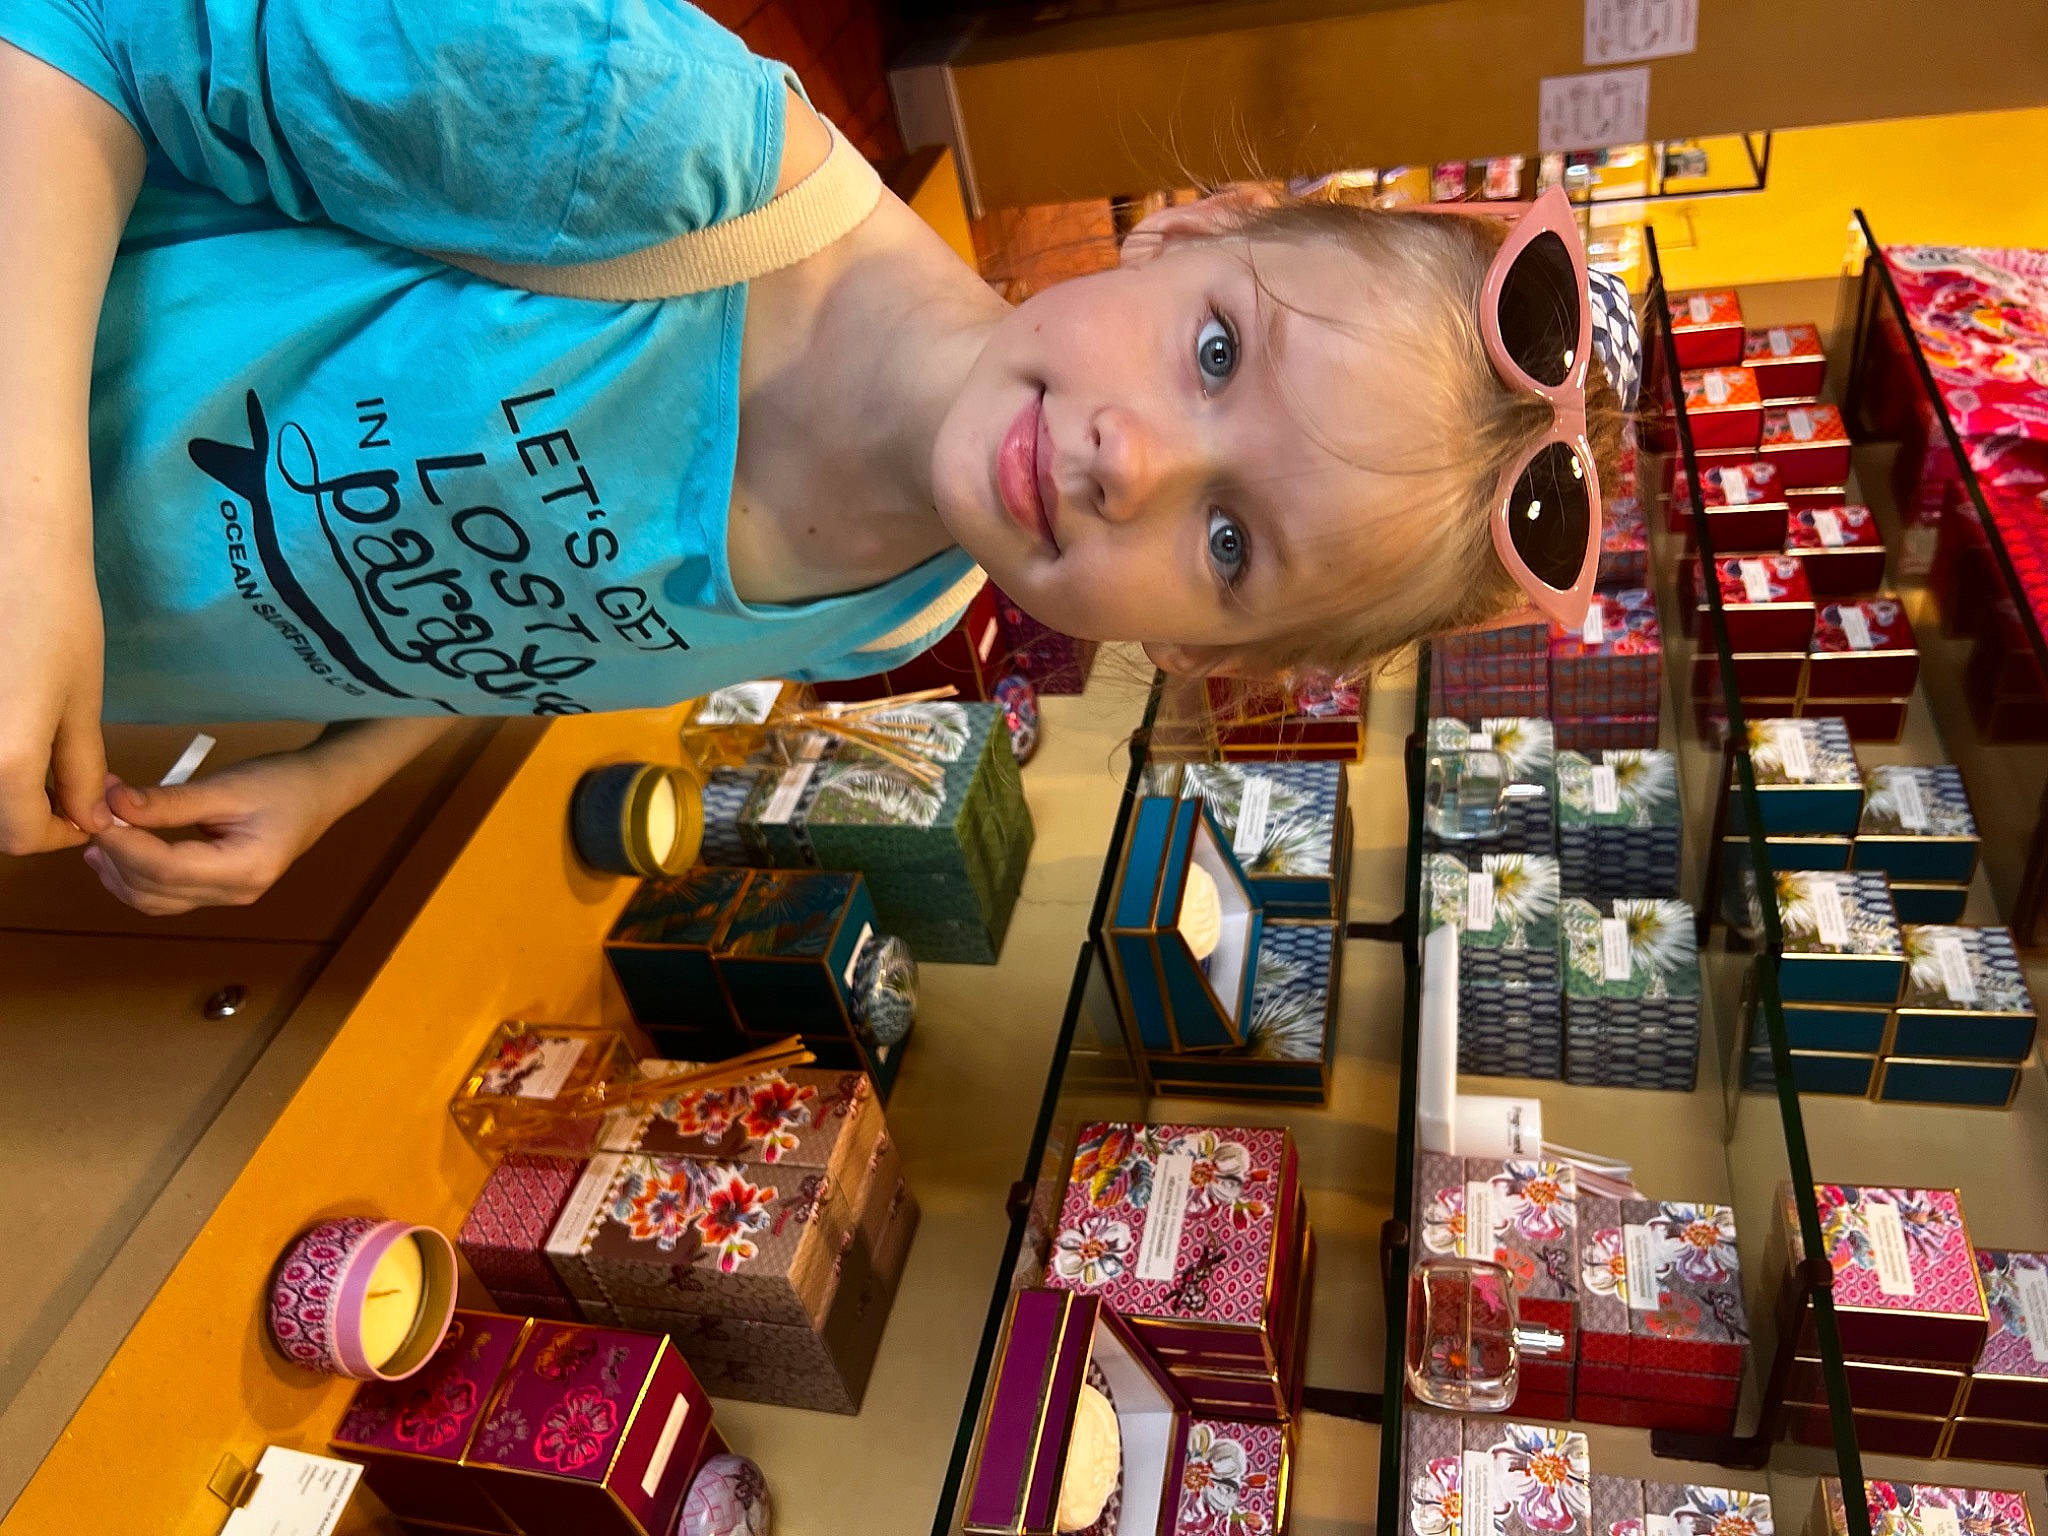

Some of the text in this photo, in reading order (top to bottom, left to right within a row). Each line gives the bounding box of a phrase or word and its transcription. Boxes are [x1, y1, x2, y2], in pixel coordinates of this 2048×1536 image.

[356, 398, 391, 449] IN
[219, 500, 263, 600] OCEAN
[252, 603, 333, 676] SURFING
[416, 452, 601, 643] LOST
[501, 388, 691, 651] LET'S GET
